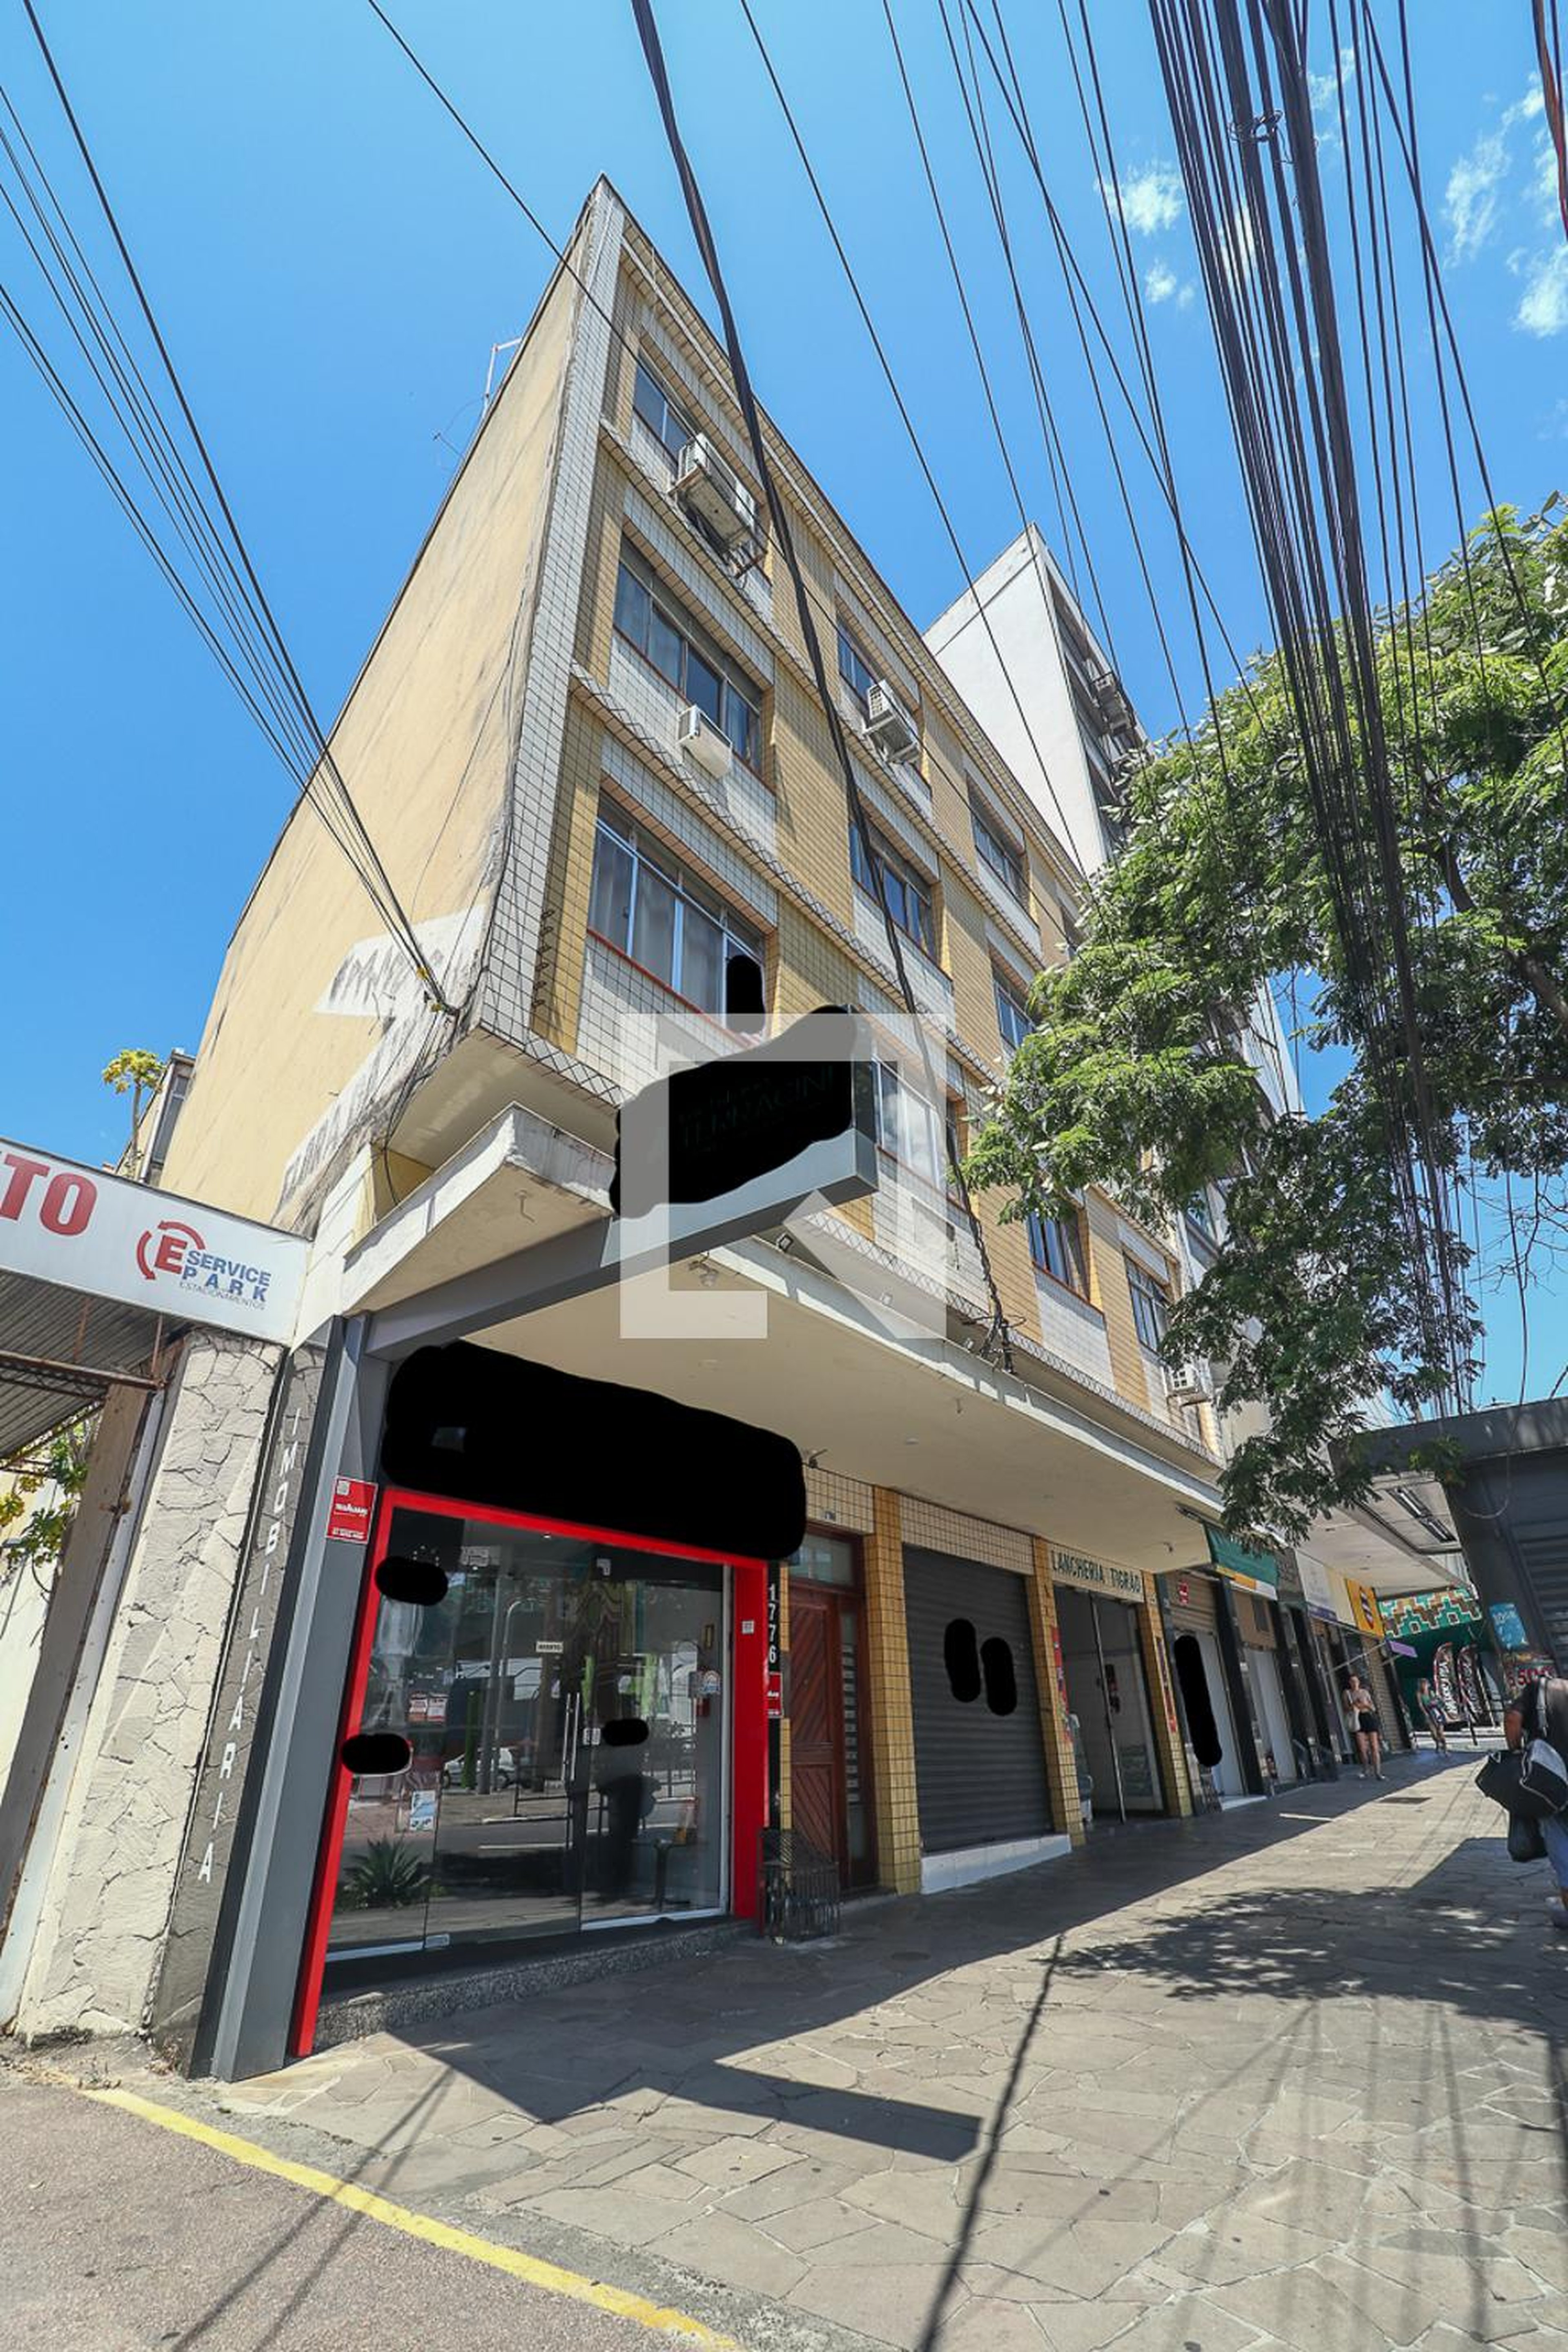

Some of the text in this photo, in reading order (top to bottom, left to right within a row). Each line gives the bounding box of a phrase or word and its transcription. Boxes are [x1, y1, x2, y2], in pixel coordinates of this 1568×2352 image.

[0, 1154, 98, 1236] TO
[183, 1265, 267, 1302] PARK
[187, 1250, 272, 1287] SERVICE
[768, 1583, 776, 1664] 1776
